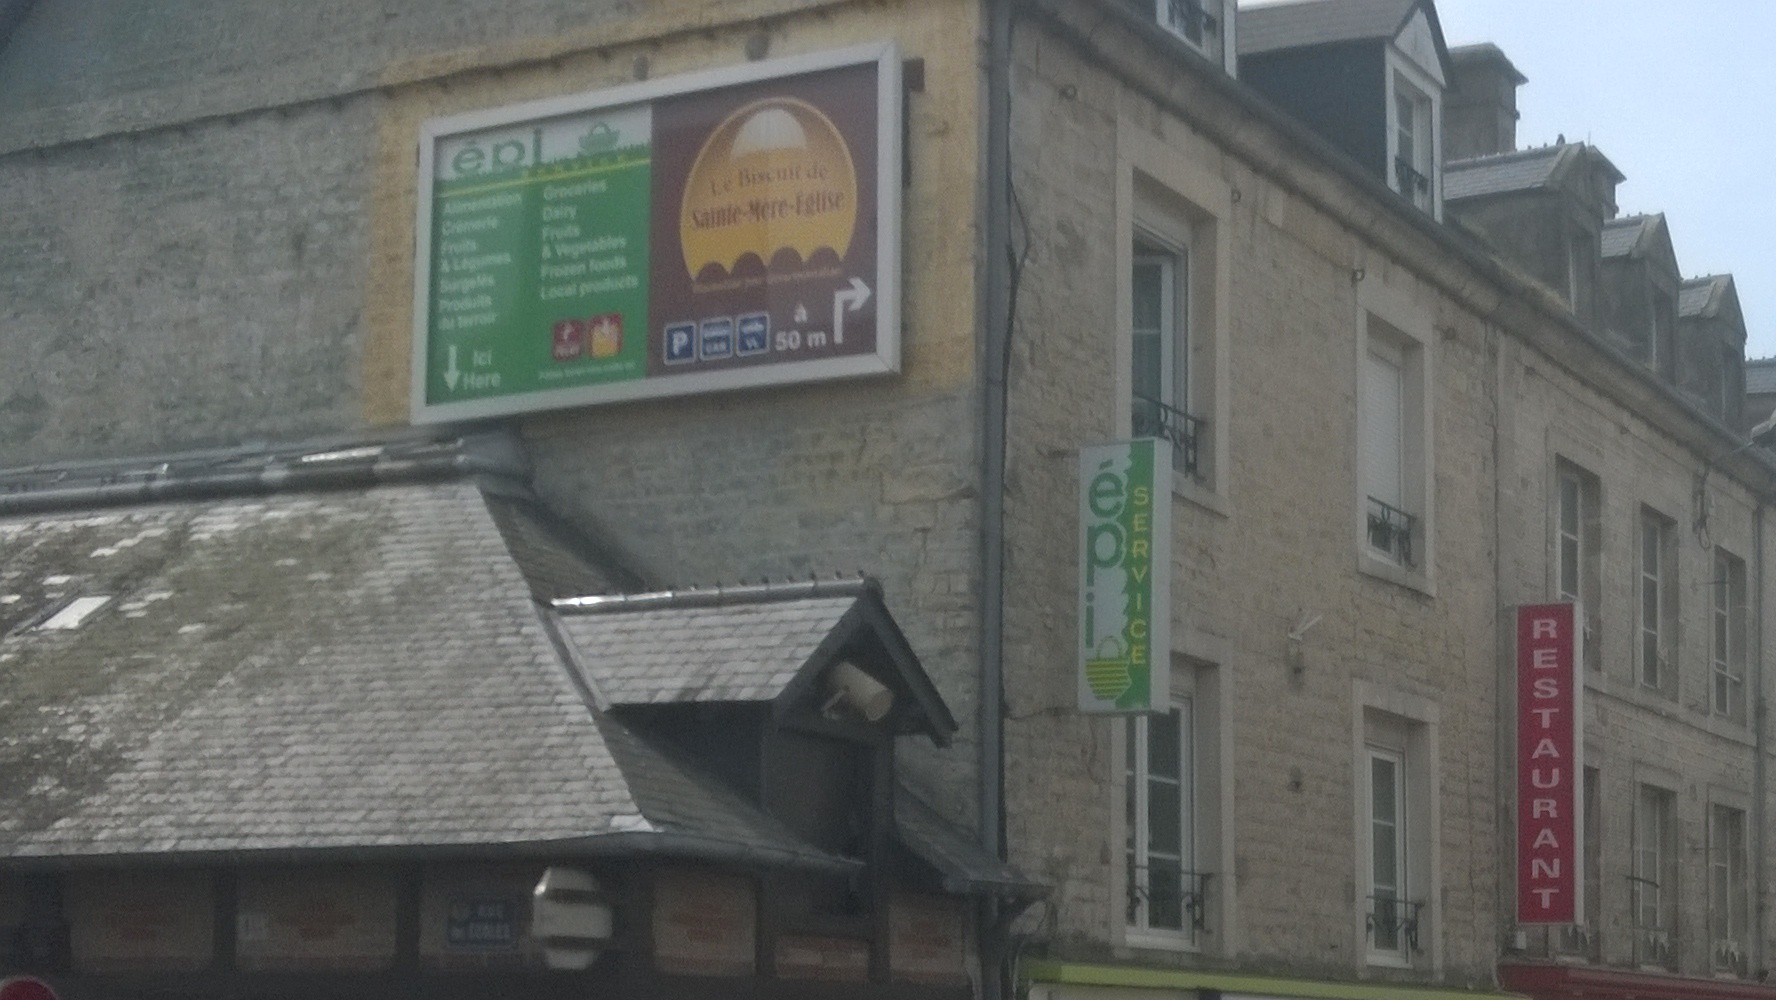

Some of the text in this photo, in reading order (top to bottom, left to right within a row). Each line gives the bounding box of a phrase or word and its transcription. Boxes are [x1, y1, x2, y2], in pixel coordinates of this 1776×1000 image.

[463, 372, 501, 389] Here
[672, 330, 689, 356] P
[774, 330, 827, 351] 50 m
[1086, 458, 1128, 650] épi
[1130, 485, 1149, 667] SERVICE
[1531, 617, 1561, 909] RESTAURANT
